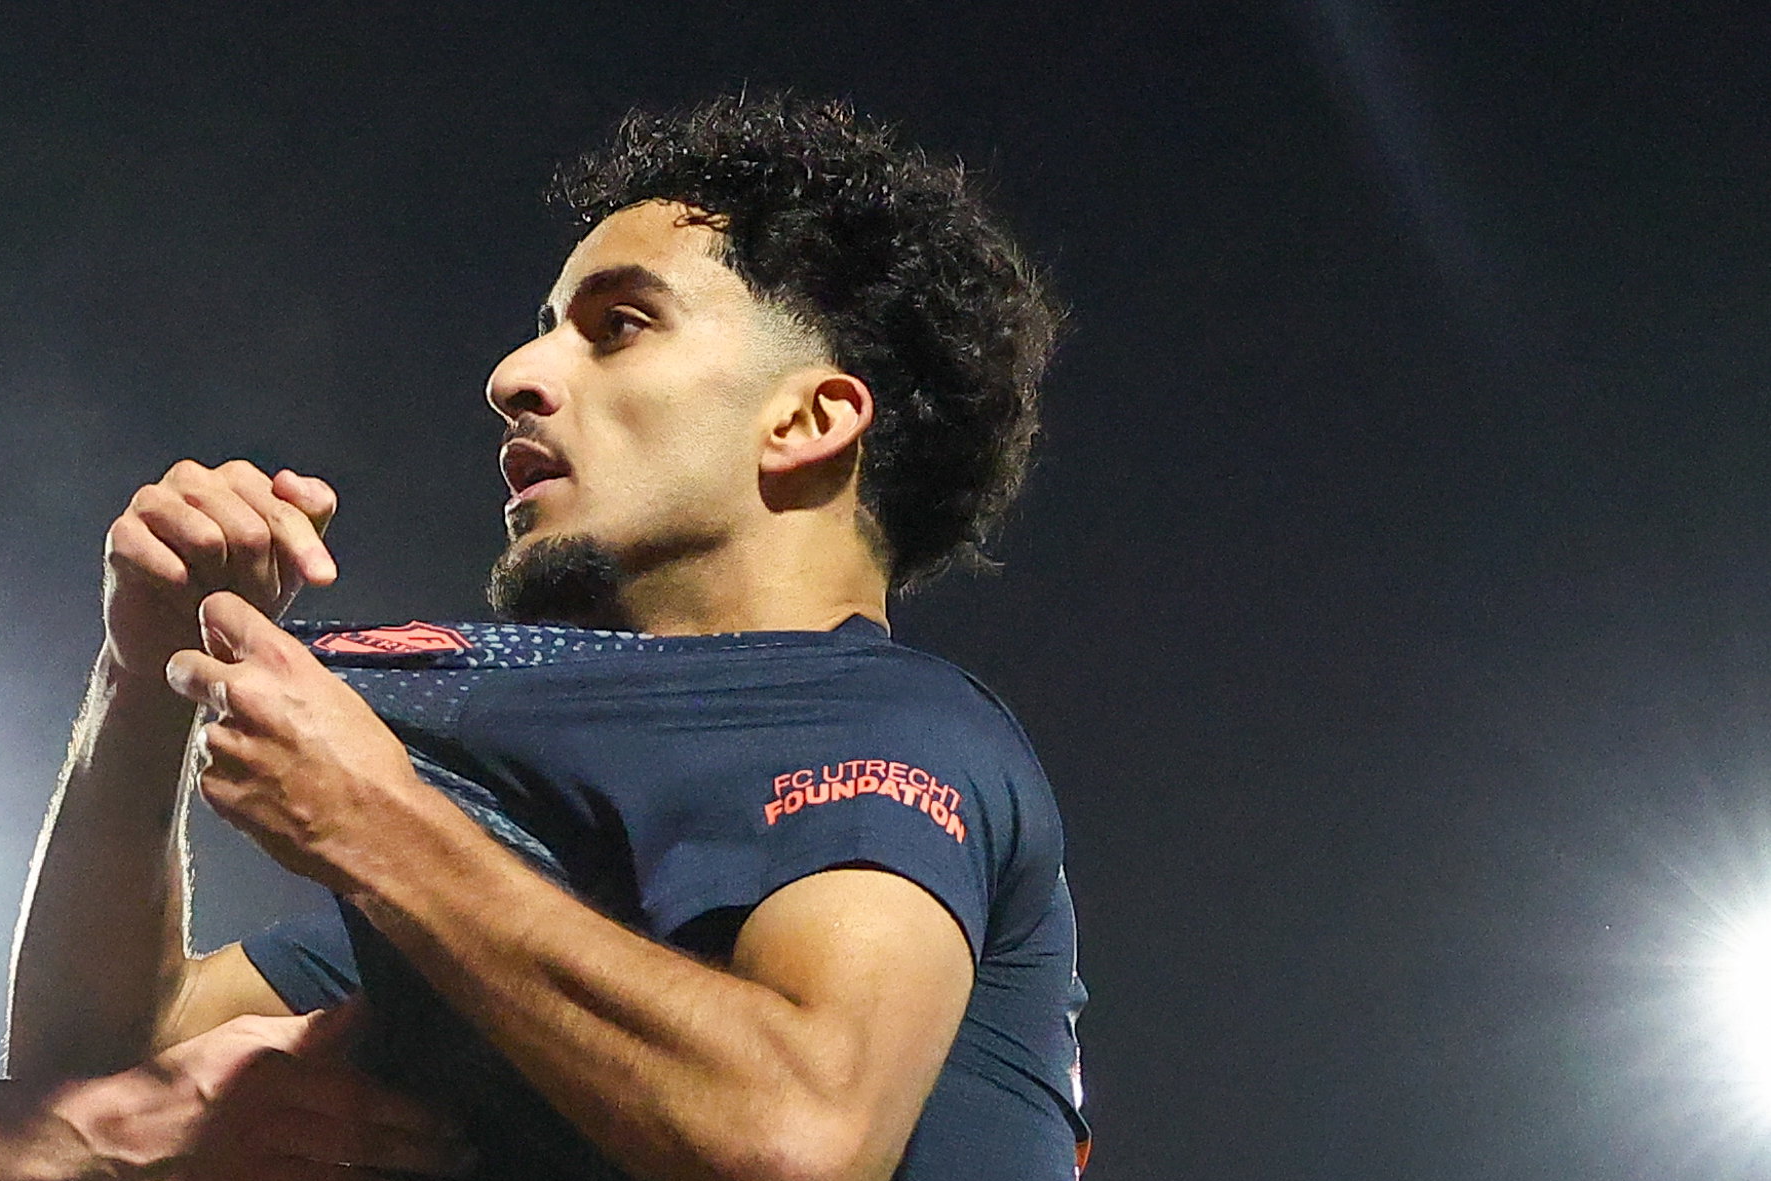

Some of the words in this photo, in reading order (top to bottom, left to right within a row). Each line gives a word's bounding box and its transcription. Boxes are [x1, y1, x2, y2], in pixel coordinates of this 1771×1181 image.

[764, 774, 968, 845] FOUNDATION
[774, 768, 813, 797] FC
[822, 758, 962, 812] UTRECHT
